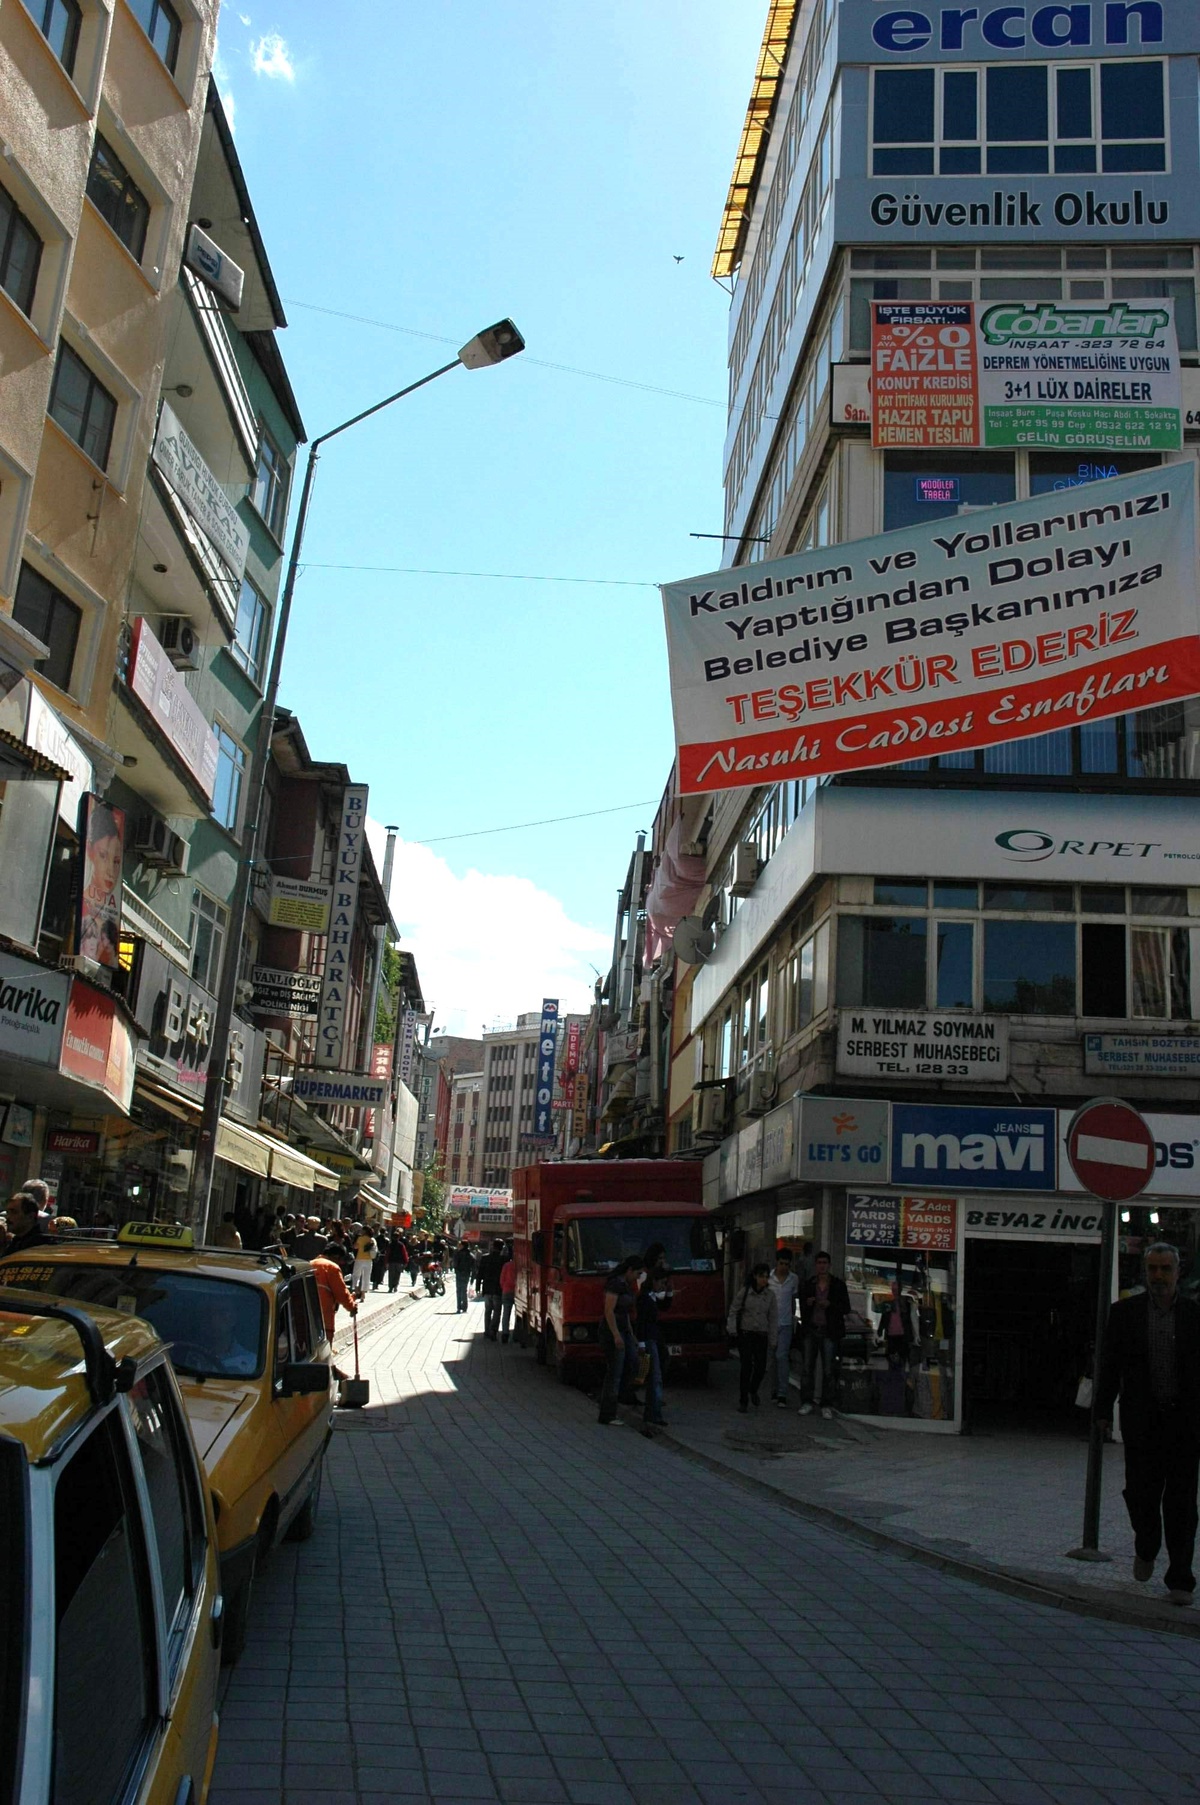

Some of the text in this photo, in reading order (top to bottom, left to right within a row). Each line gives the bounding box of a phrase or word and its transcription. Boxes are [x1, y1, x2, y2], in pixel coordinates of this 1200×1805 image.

[872, 1, 1164, 52] ercan
[871, 190, 1168, 227] Güvenlik Okulu
[915, 305, 967, 315] BÜYÜK
[984, 305, 1169, 344] Çobanlar
[1009, 339, 1070, 350] İNŞAAT
[1119, 340, 1139, 349] 72
[1145, 340, 1166, 349] 64
[983, 353, 1171, 371] DEPREM YÖNETMELİĞİNE UYGUN
[877, 373, 972, 390] KONUT KREDİSİ
[1004, 377, 1152, 400] 3+1 LÜX DAİRELER
[877, 395, 893, 407] KAT
[930, 394, 974, 409] KURULMUŞ
[844, 404, 870, 421] San.
[878, 409, 973, 425] HAZIR TAPU
[1144, 410, 1176, 420] Sokakta
[1012, 419, 1032, 427] 212
[1095, 421, 1121, 429] 0532
[1149, 422, 1163, 430] 12
[878, 427, 923, 443] HEMEN
[1016, 431, 1151, 446] GELİN GÖRÜŞELİM
[165, 436, 244, 549] AVUKAT
[923, 490, 951, 500] TABELA
[689, 492, 1171, 616] Kaldırım ve Yollarımızı
[726, 538, 1131, 642] Yaptığından Dolayı
[705, 562, 1164, 683] Belediye Başkanımıza
[726, 608, 1140, 726] TEŞEKKÜR EDERİZ
[695, 665, 1169, 783] Nasuhi Caddesi Esnafları
[322, 796, 362, 1059] BÜYÜK BAHARATÇI
[0, 978, 61, 1025] arika
[851, 1017, 995, 1039] M. YILMAZ SOYMAN
[846, 1041, 909, 1059] SERBEST
[1152, 1039, 1200, 1048] BOZTEPE
[1097, 1051, 1139, 1062] SERBEST
[537, 1018, 557, 1132] metot
[915, 1063, 943, 1074] 128
[946, 1064, 969, 1075] 33
[293, 1076, 384, 1103] SÜPERMARKET
[993, 1122, 1031, 1134] JEANS
[53, 1135, 91, 1149] Harika
[901, 1124, 1045, 1172] mavi
[808, 1142, 851, 1162] LET'S
[857, 1144, 882, 1164] GO
[854, 1195, 896, 1209] 2 Adet
[910, 1199, 951, 1212] 2 Adet
[851, 1210, 896, 1221] YARDS
[907, 1214, 952, 1224] YARDS
[966, 1210, 1047, 1229] BEYAZ
